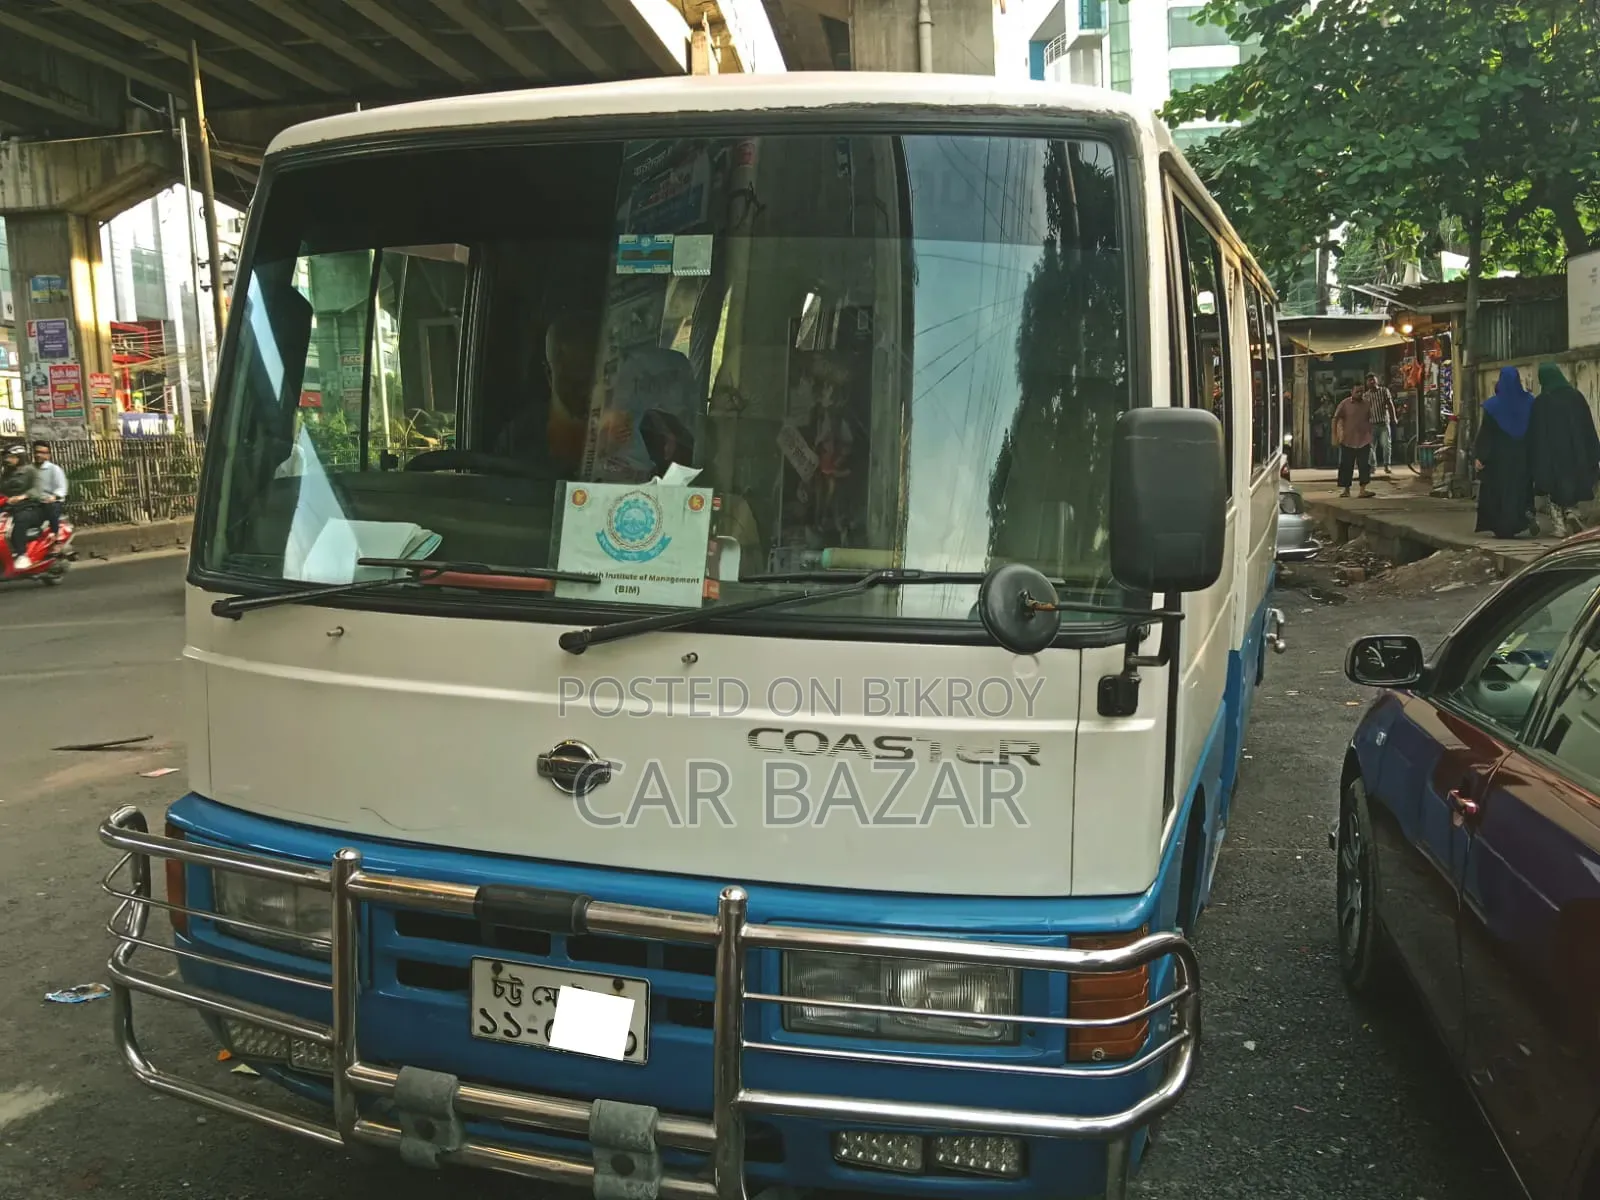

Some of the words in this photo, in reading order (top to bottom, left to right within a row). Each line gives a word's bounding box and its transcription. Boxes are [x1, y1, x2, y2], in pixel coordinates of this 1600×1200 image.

[605, 572, 638, 581] Institute
[639, 573, 647, 581] of
[649, 574, 700, 584] Management
[614, 584, 641, 596] (BIM)
